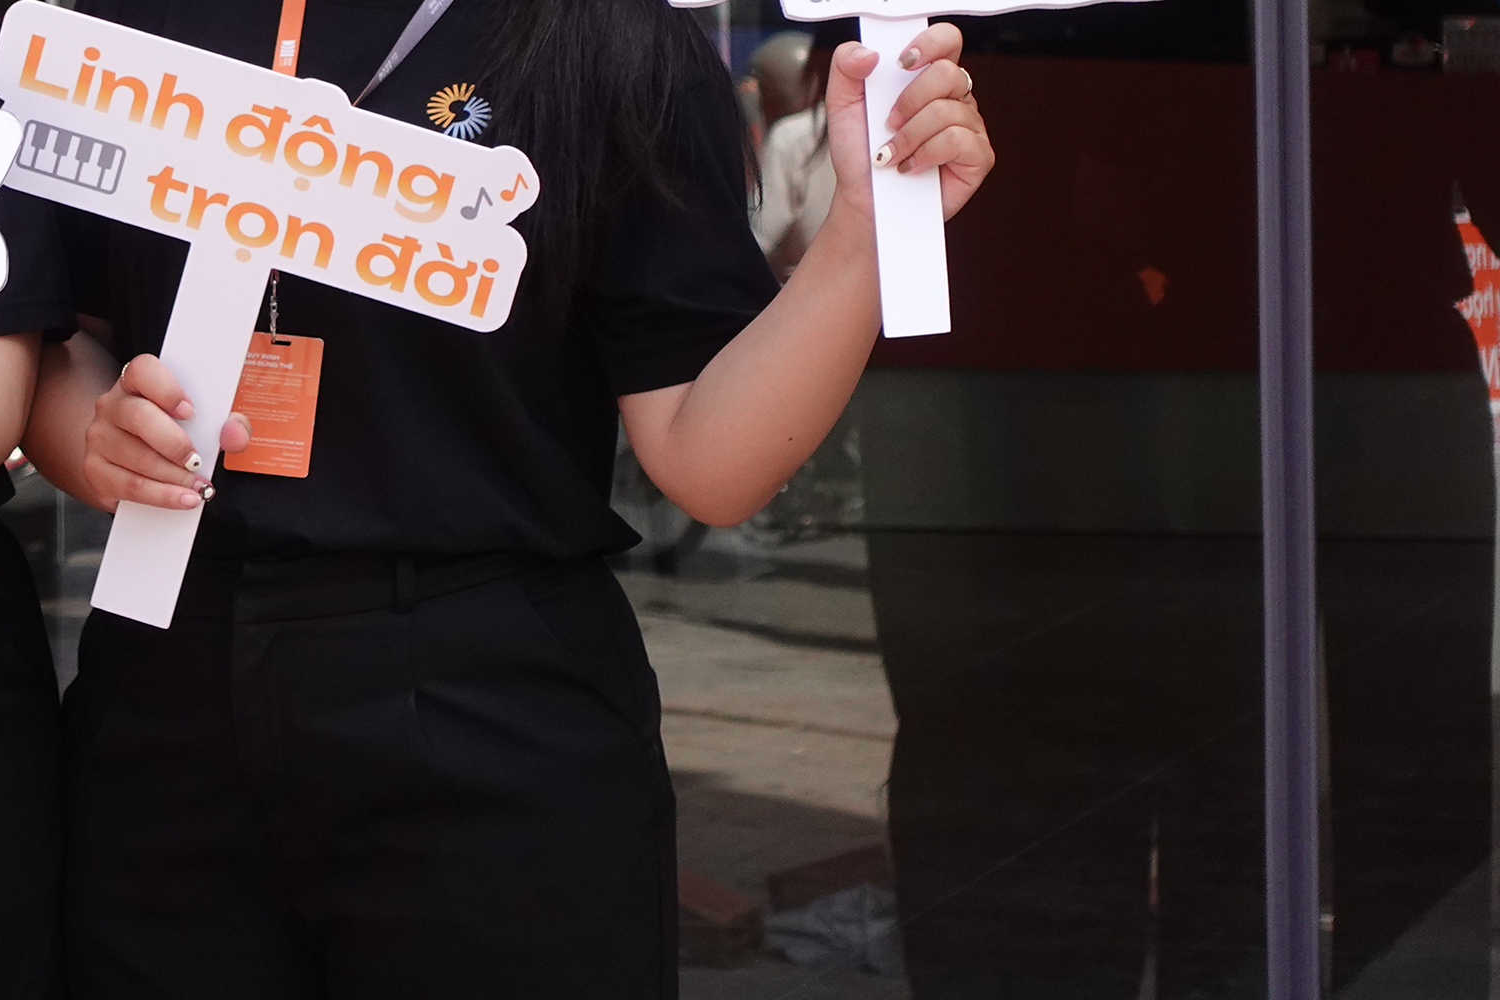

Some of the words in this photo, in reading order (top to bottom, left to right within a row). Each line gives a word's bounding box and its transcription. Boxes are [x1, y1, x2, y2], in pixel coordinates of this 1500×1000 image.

[18, 33, 204, 140] Linh
[224, 103, 456, 224] động
[146, 166, 336, 271] trọn
[355, 232, 501, 319] đời
